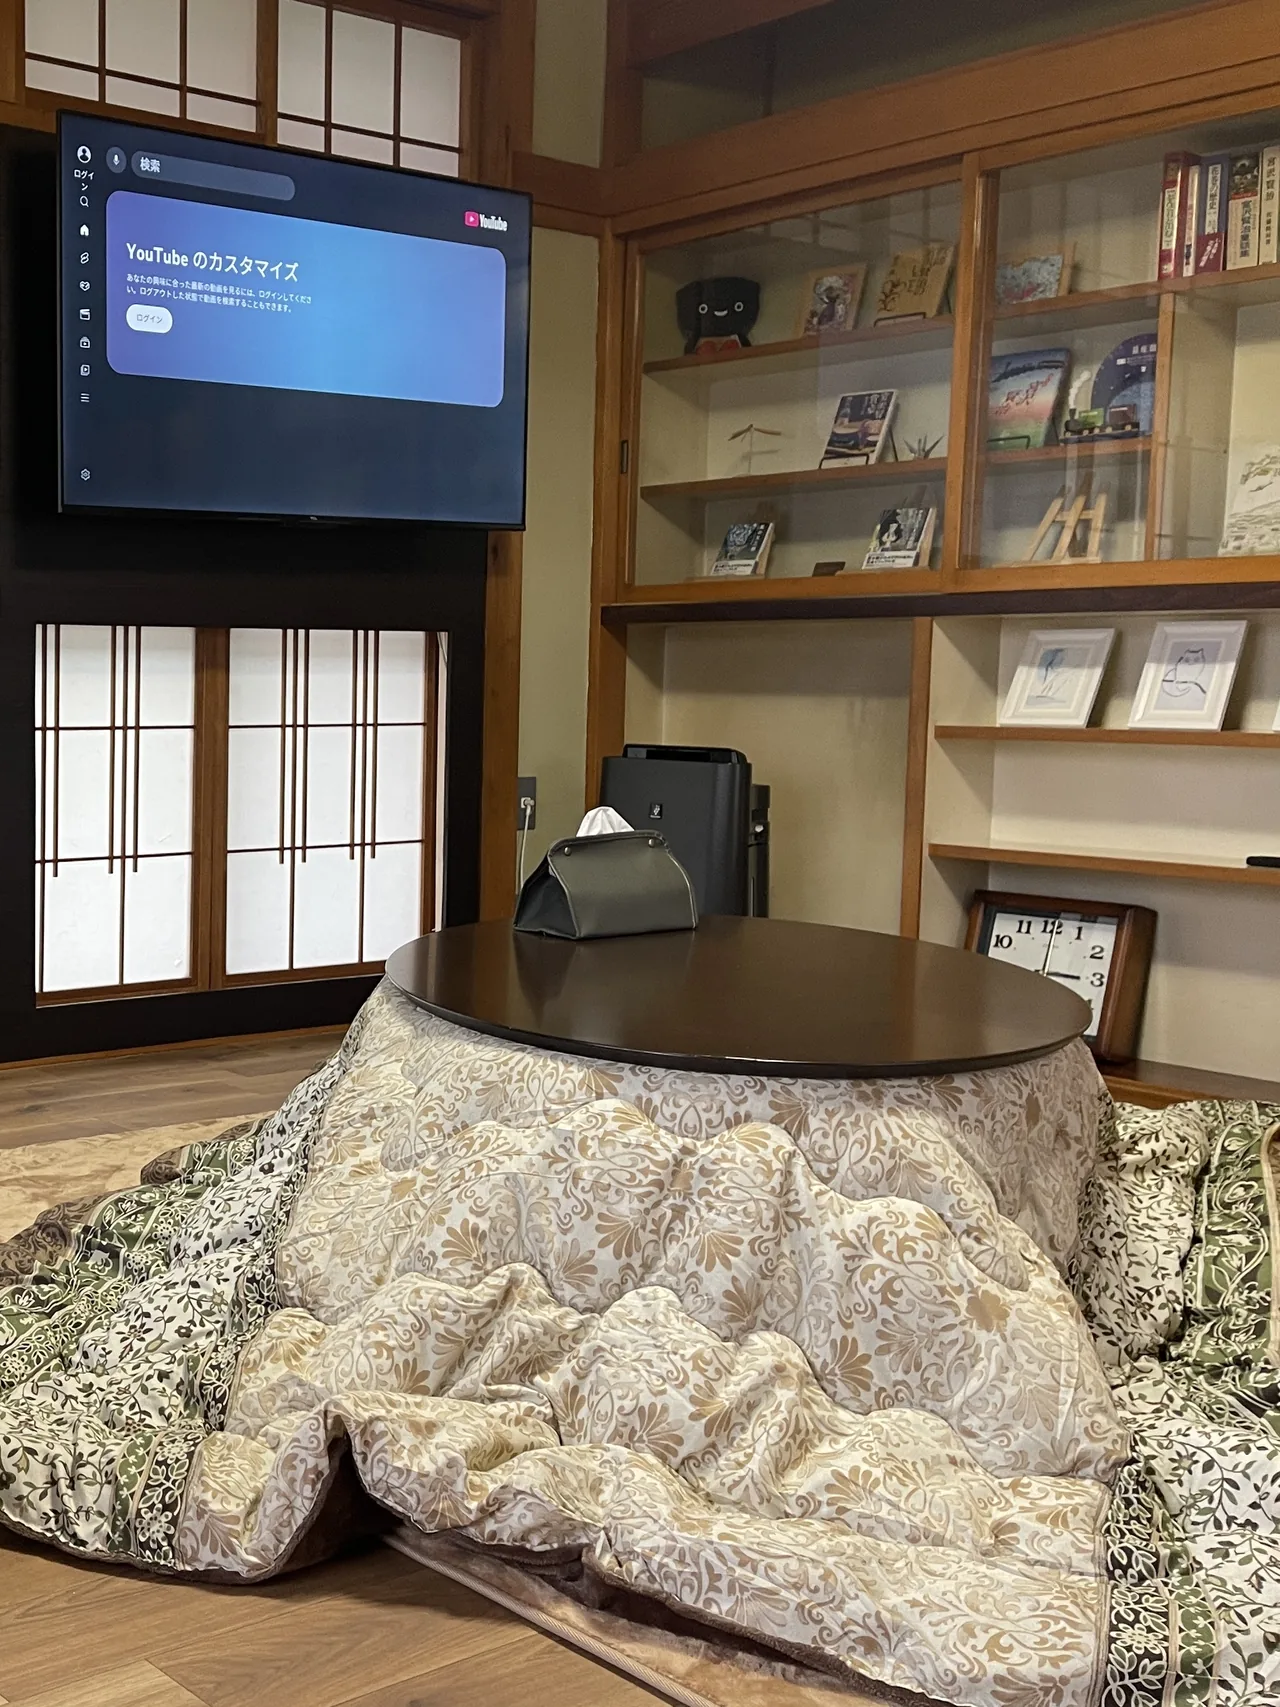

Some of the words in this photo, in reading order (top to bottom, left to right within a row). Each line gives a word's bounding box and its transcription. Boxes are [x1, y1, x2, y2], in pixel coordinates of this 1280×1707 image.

[140, 157, 160, 173] 検索
[479, 213, 508, 231] YouTube
[126, 243, 189, 267] YouTube
[193, 251, 299, 282] のカスタマイズ
[136, 313, 163, 324] ログイン
[1016, 920, 1032, 935] 11
[1041, 919, 1064, 935] 12
[1075, 926, 1084, 941] 1
[993, 934, 1013, 949] 10
[1089, 945, 1105, 960] 2
[1090, 972, 1105, 988] 3
